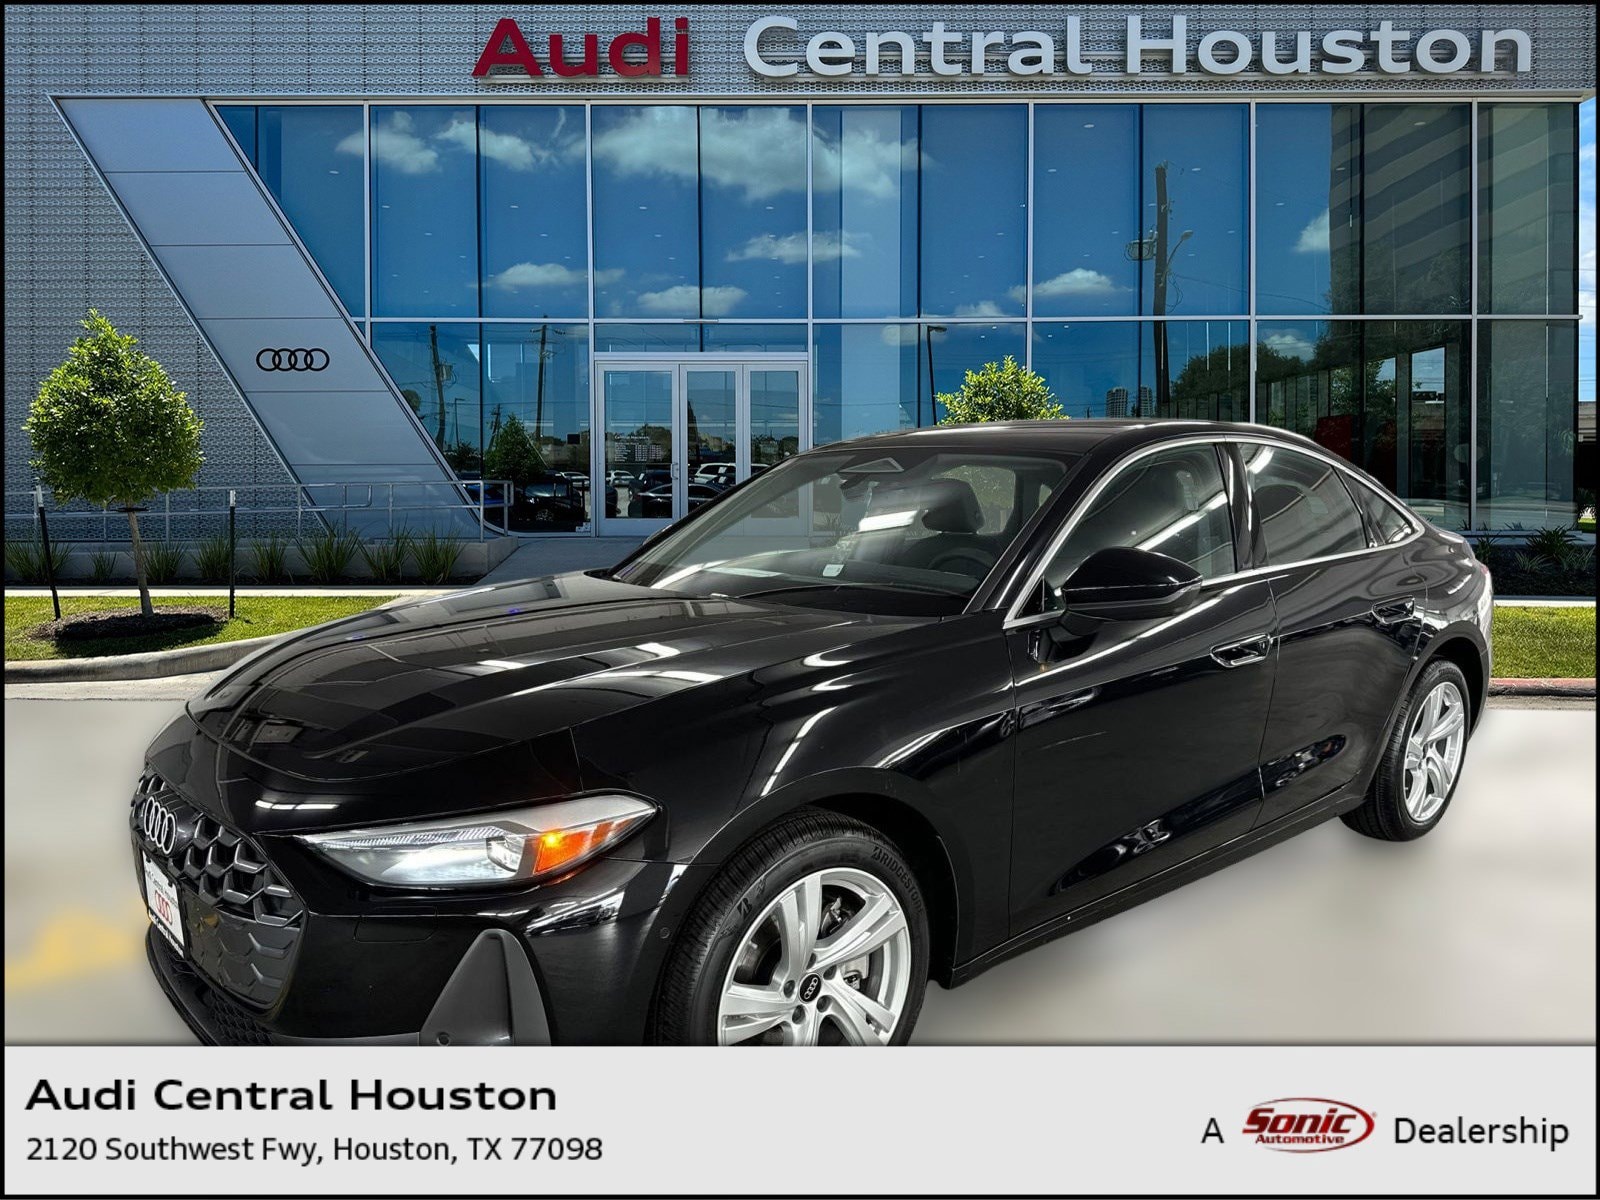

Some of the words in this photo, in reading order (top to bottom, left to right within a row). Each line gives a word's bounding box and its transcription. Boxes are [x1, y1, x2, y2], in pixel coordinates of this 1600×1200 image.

[471, 17, 689, 77] Audi
[743, 15, 1093, 77] Central
[1127, 15, 1532, 75] Houston
